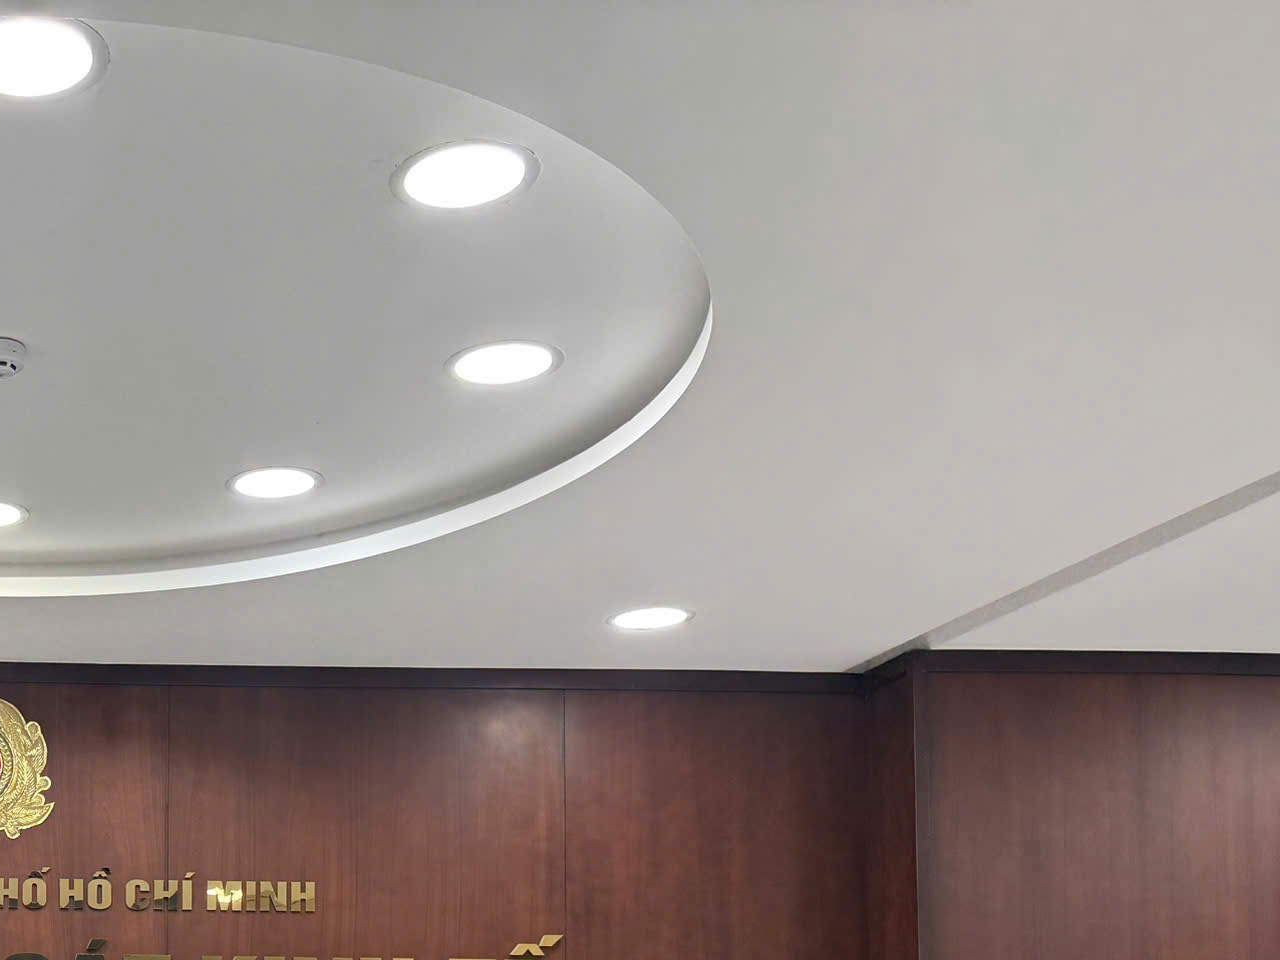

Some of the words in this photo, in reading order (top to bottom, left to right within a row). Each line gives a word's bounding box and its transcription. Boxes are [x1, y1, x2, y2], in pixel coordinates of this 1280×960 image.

[59, 868, 113, 911] HỒ
[125, 871, 196, 912] CHÍ
[206, 880, 316, 912] MINH
